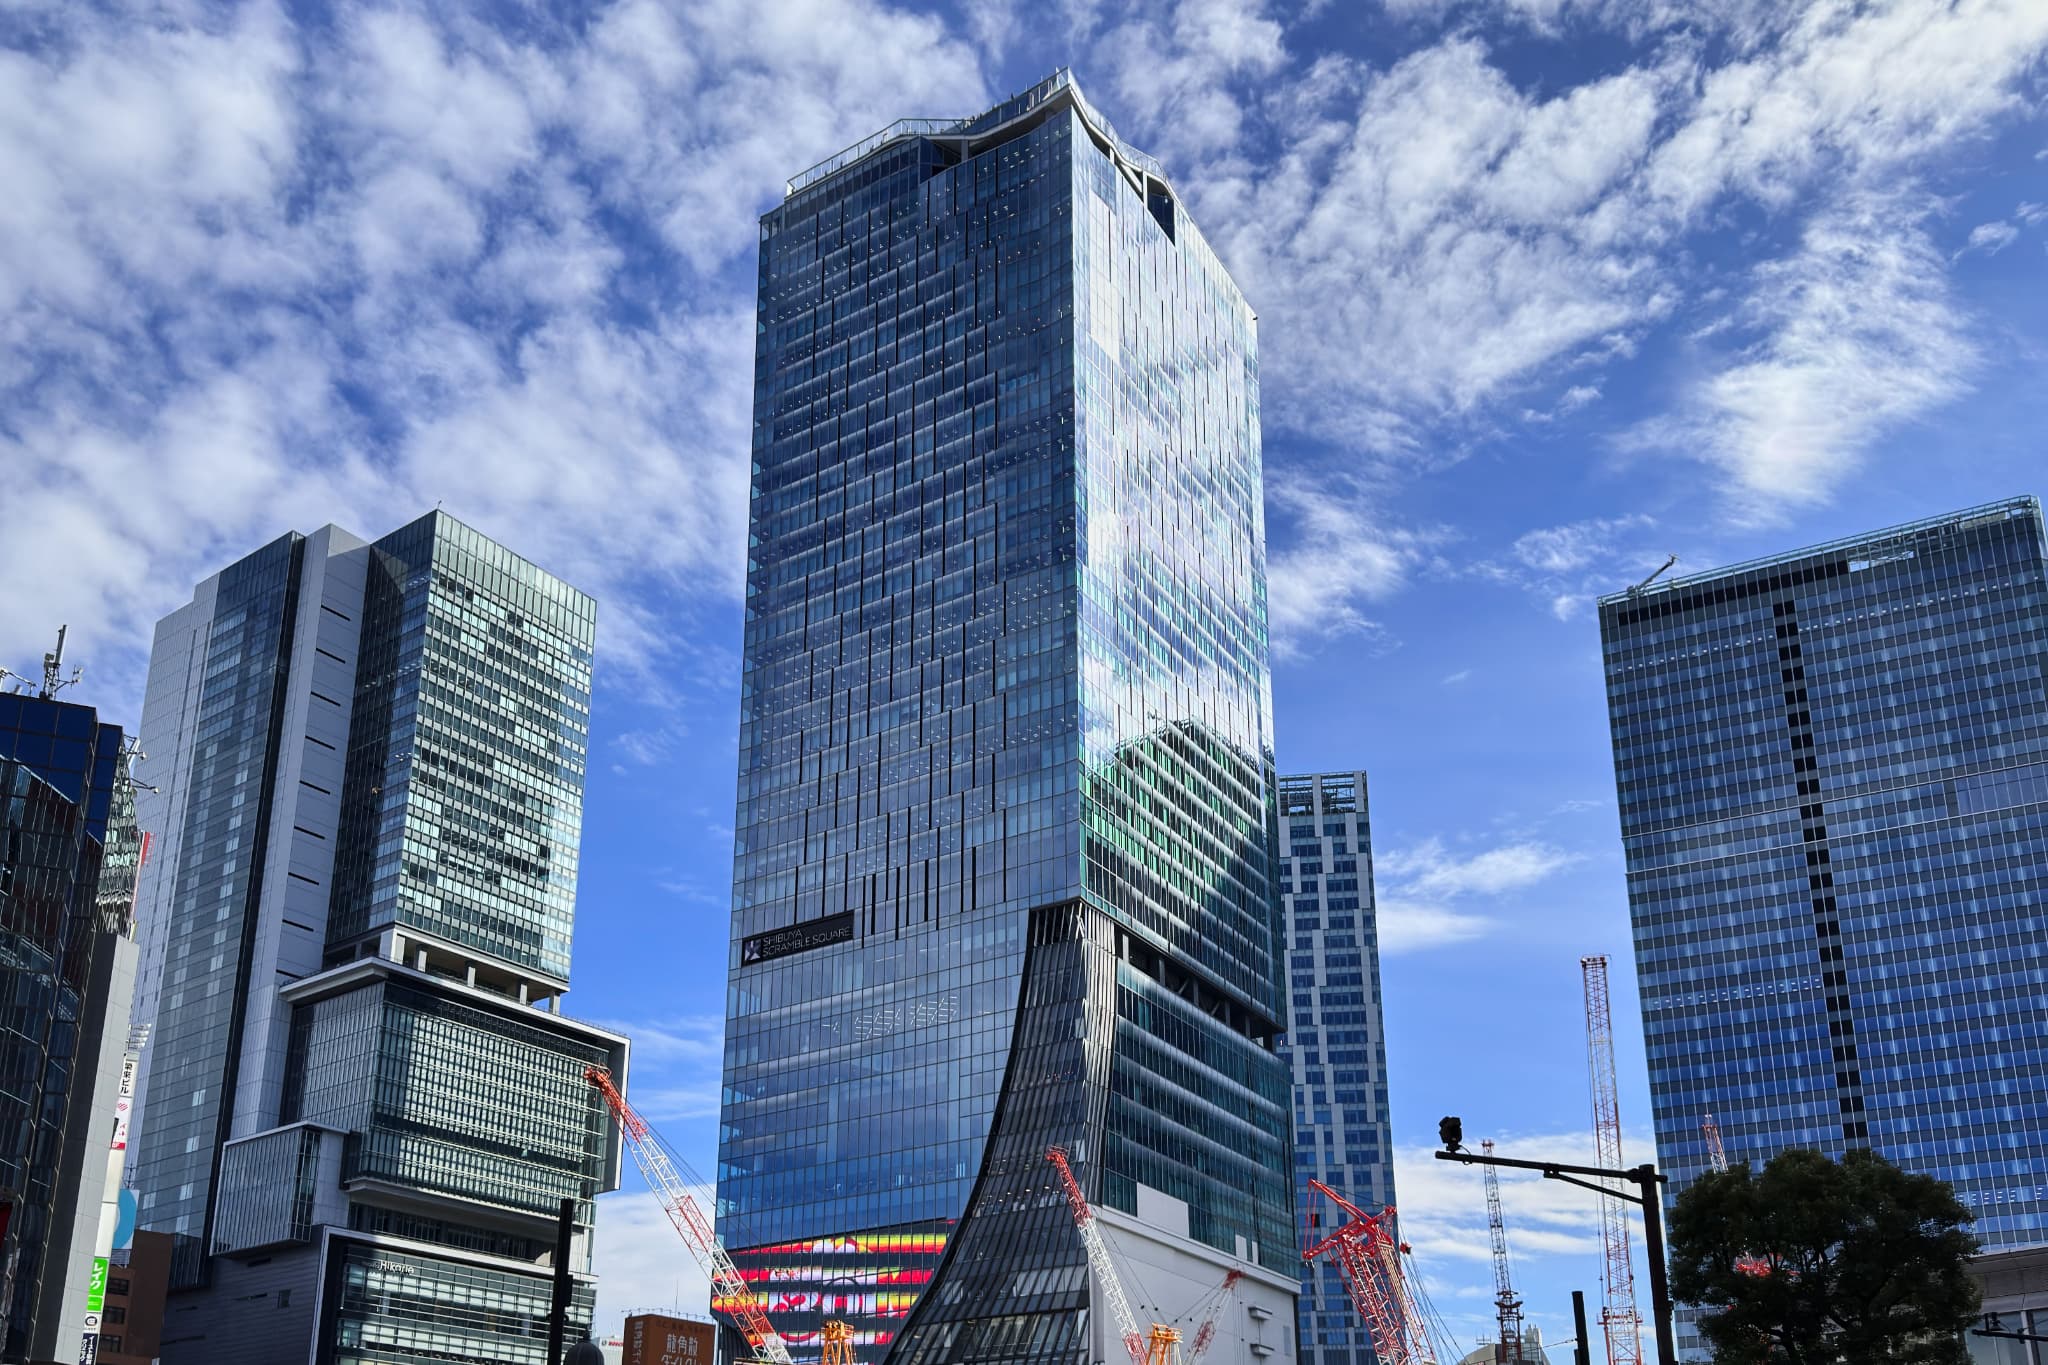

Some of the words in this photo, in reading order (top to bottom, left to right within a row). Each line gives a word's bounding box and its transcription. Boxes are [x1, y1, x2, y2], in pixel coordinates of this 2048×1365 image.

[763, 929, 802, 947] SHIBUYA
[763, 937, 811, 957] SCRAMBLE
[812, 926, 851, 943] SQUARE
[90, 1262, 103, 1290] レイク
[379, 1260, 415, 1274] Hikarie
